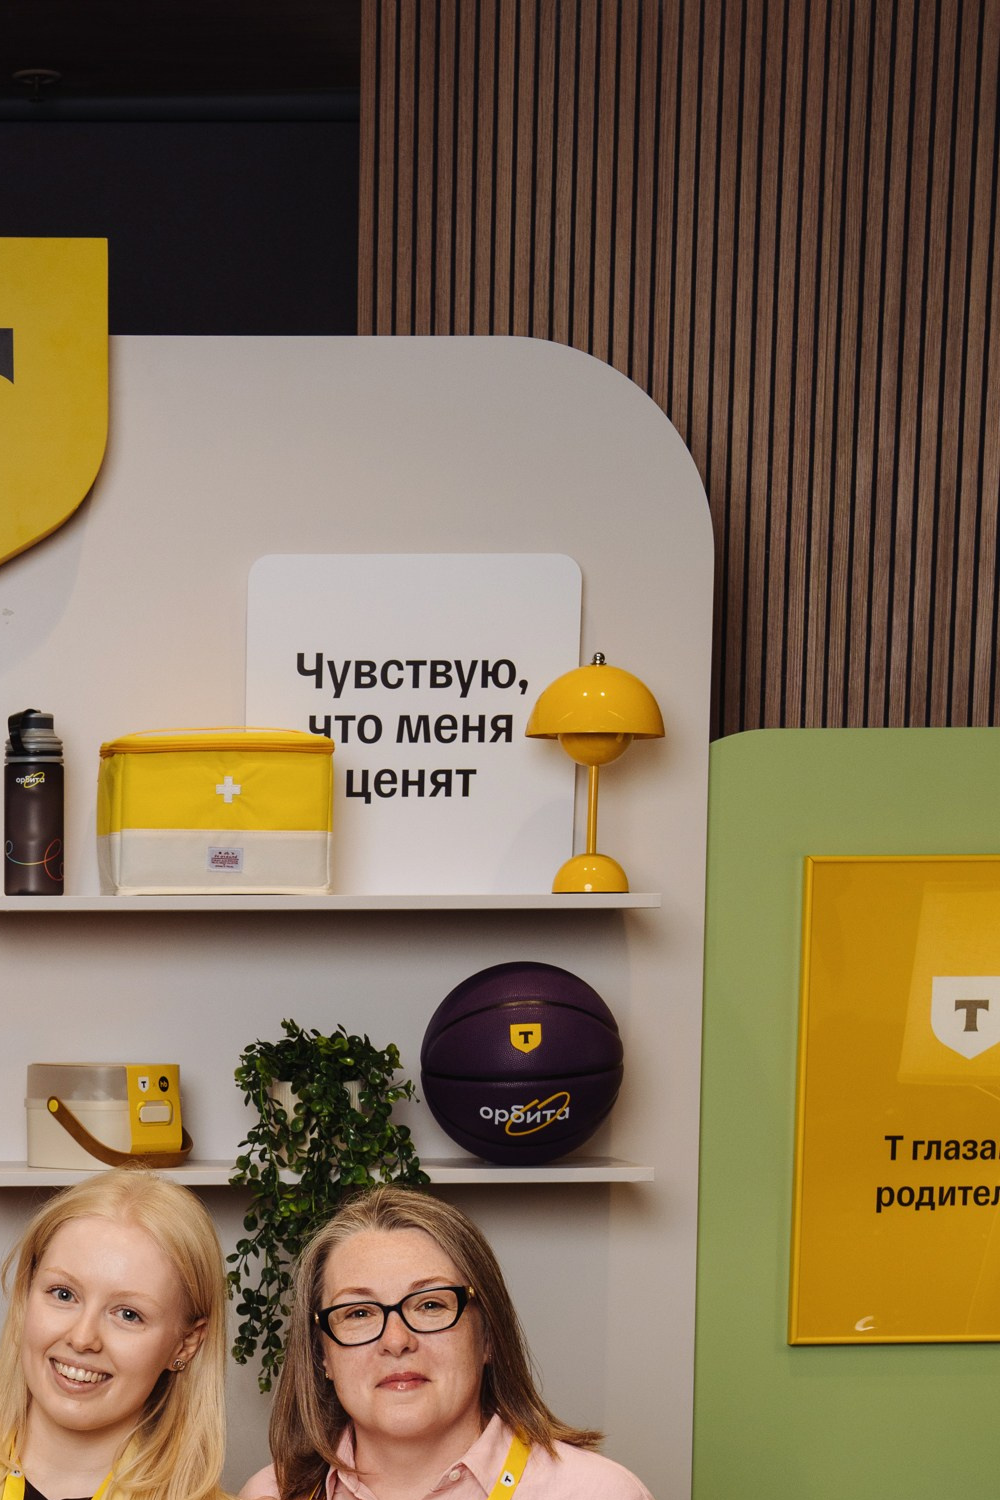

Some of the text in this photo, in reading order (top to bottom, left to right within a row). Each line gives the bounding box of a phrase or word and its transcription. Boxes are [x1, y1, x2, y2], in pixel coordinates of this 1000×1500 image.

[296, 652, 529, 699] Чувствую,
[308, 714, 513, 744] что меня
[345, 768, 477, 804] ценят
[479, 1101, 570, 1128] орбита
[884, 1135, 1000, 1161] Т глаза
